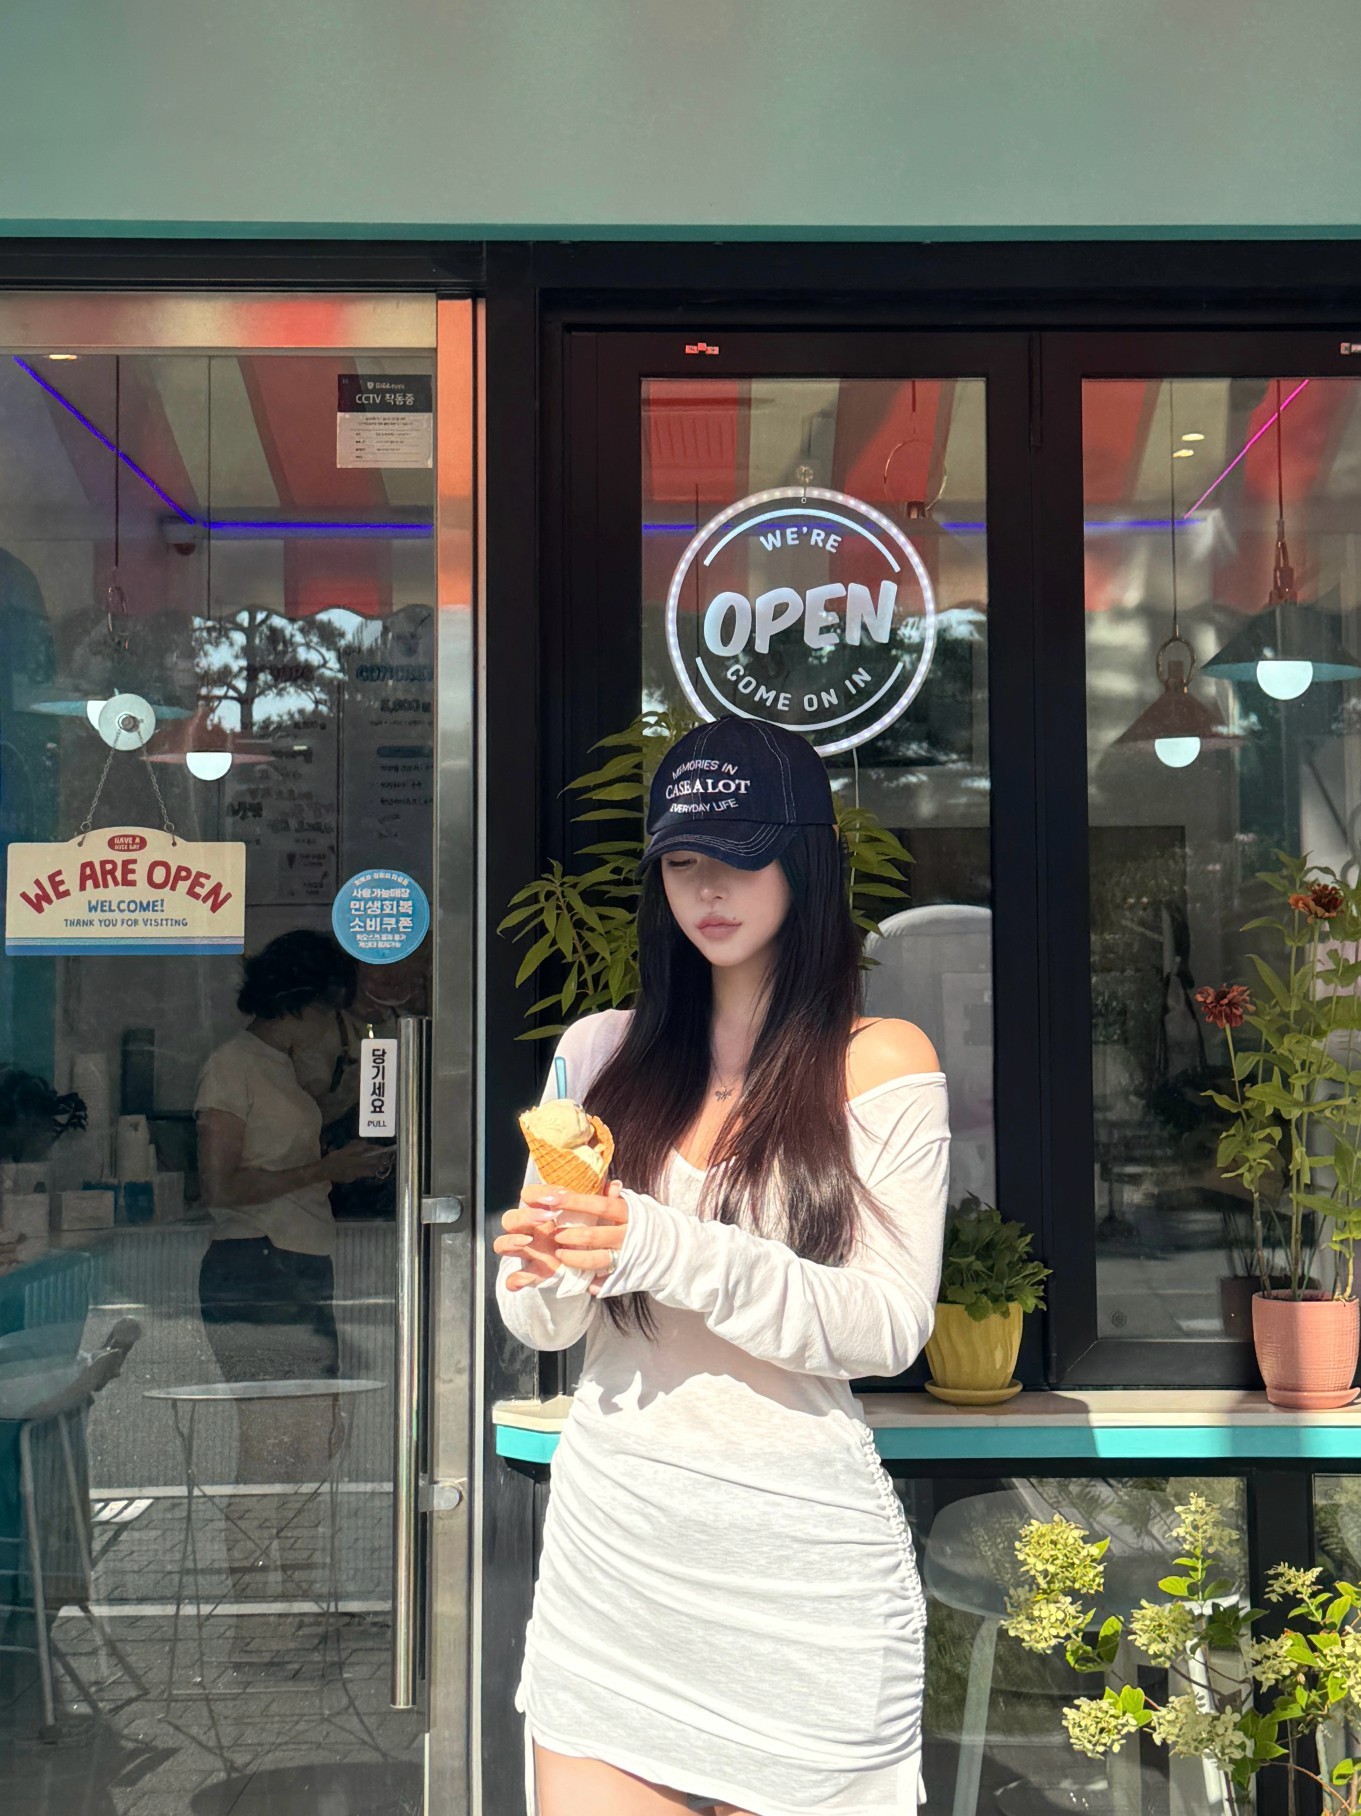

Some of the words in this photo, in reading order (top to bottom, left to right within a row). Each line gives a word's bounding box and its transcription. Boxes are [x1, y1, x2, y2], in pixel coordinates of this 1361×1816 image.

[356, 394, 382, 404] CCTV
[384, 393, 415, 406] 작동중
[759, 527, 842, 554] WE'RE
[703, 579, 898, 657] OPEN
[726, 664, 793, 712] COME
[803, 688, 839, 712] ON
[844, 667, 872, 695] IN
[672, 759, 719, 780] MEMORIES
[721, 762, 738, 775] IN
[669, 803, 710, 814] EVERYDAY
[713, 798, 739, 811] LIFE
[19, 869, 71, 914] WE
[79, 858, 138, 892] ARE
[146, 860, 233, 914] OPEN
[87, 898, 165, 914] WELCOME!
[349, 900, 413, 915] 민생회복
[64, 918, 95, 928] THANK
[98, 918, 118, 928] YOU
[120, 918, 139, 928] FOR
[142, 918, 188, 927] VISITING
[349, 917, 413, 932] 소비쿠폰
[370, 1048, 387, 1114] 당기세요
[367, 1120, 387, 1128] PULL
